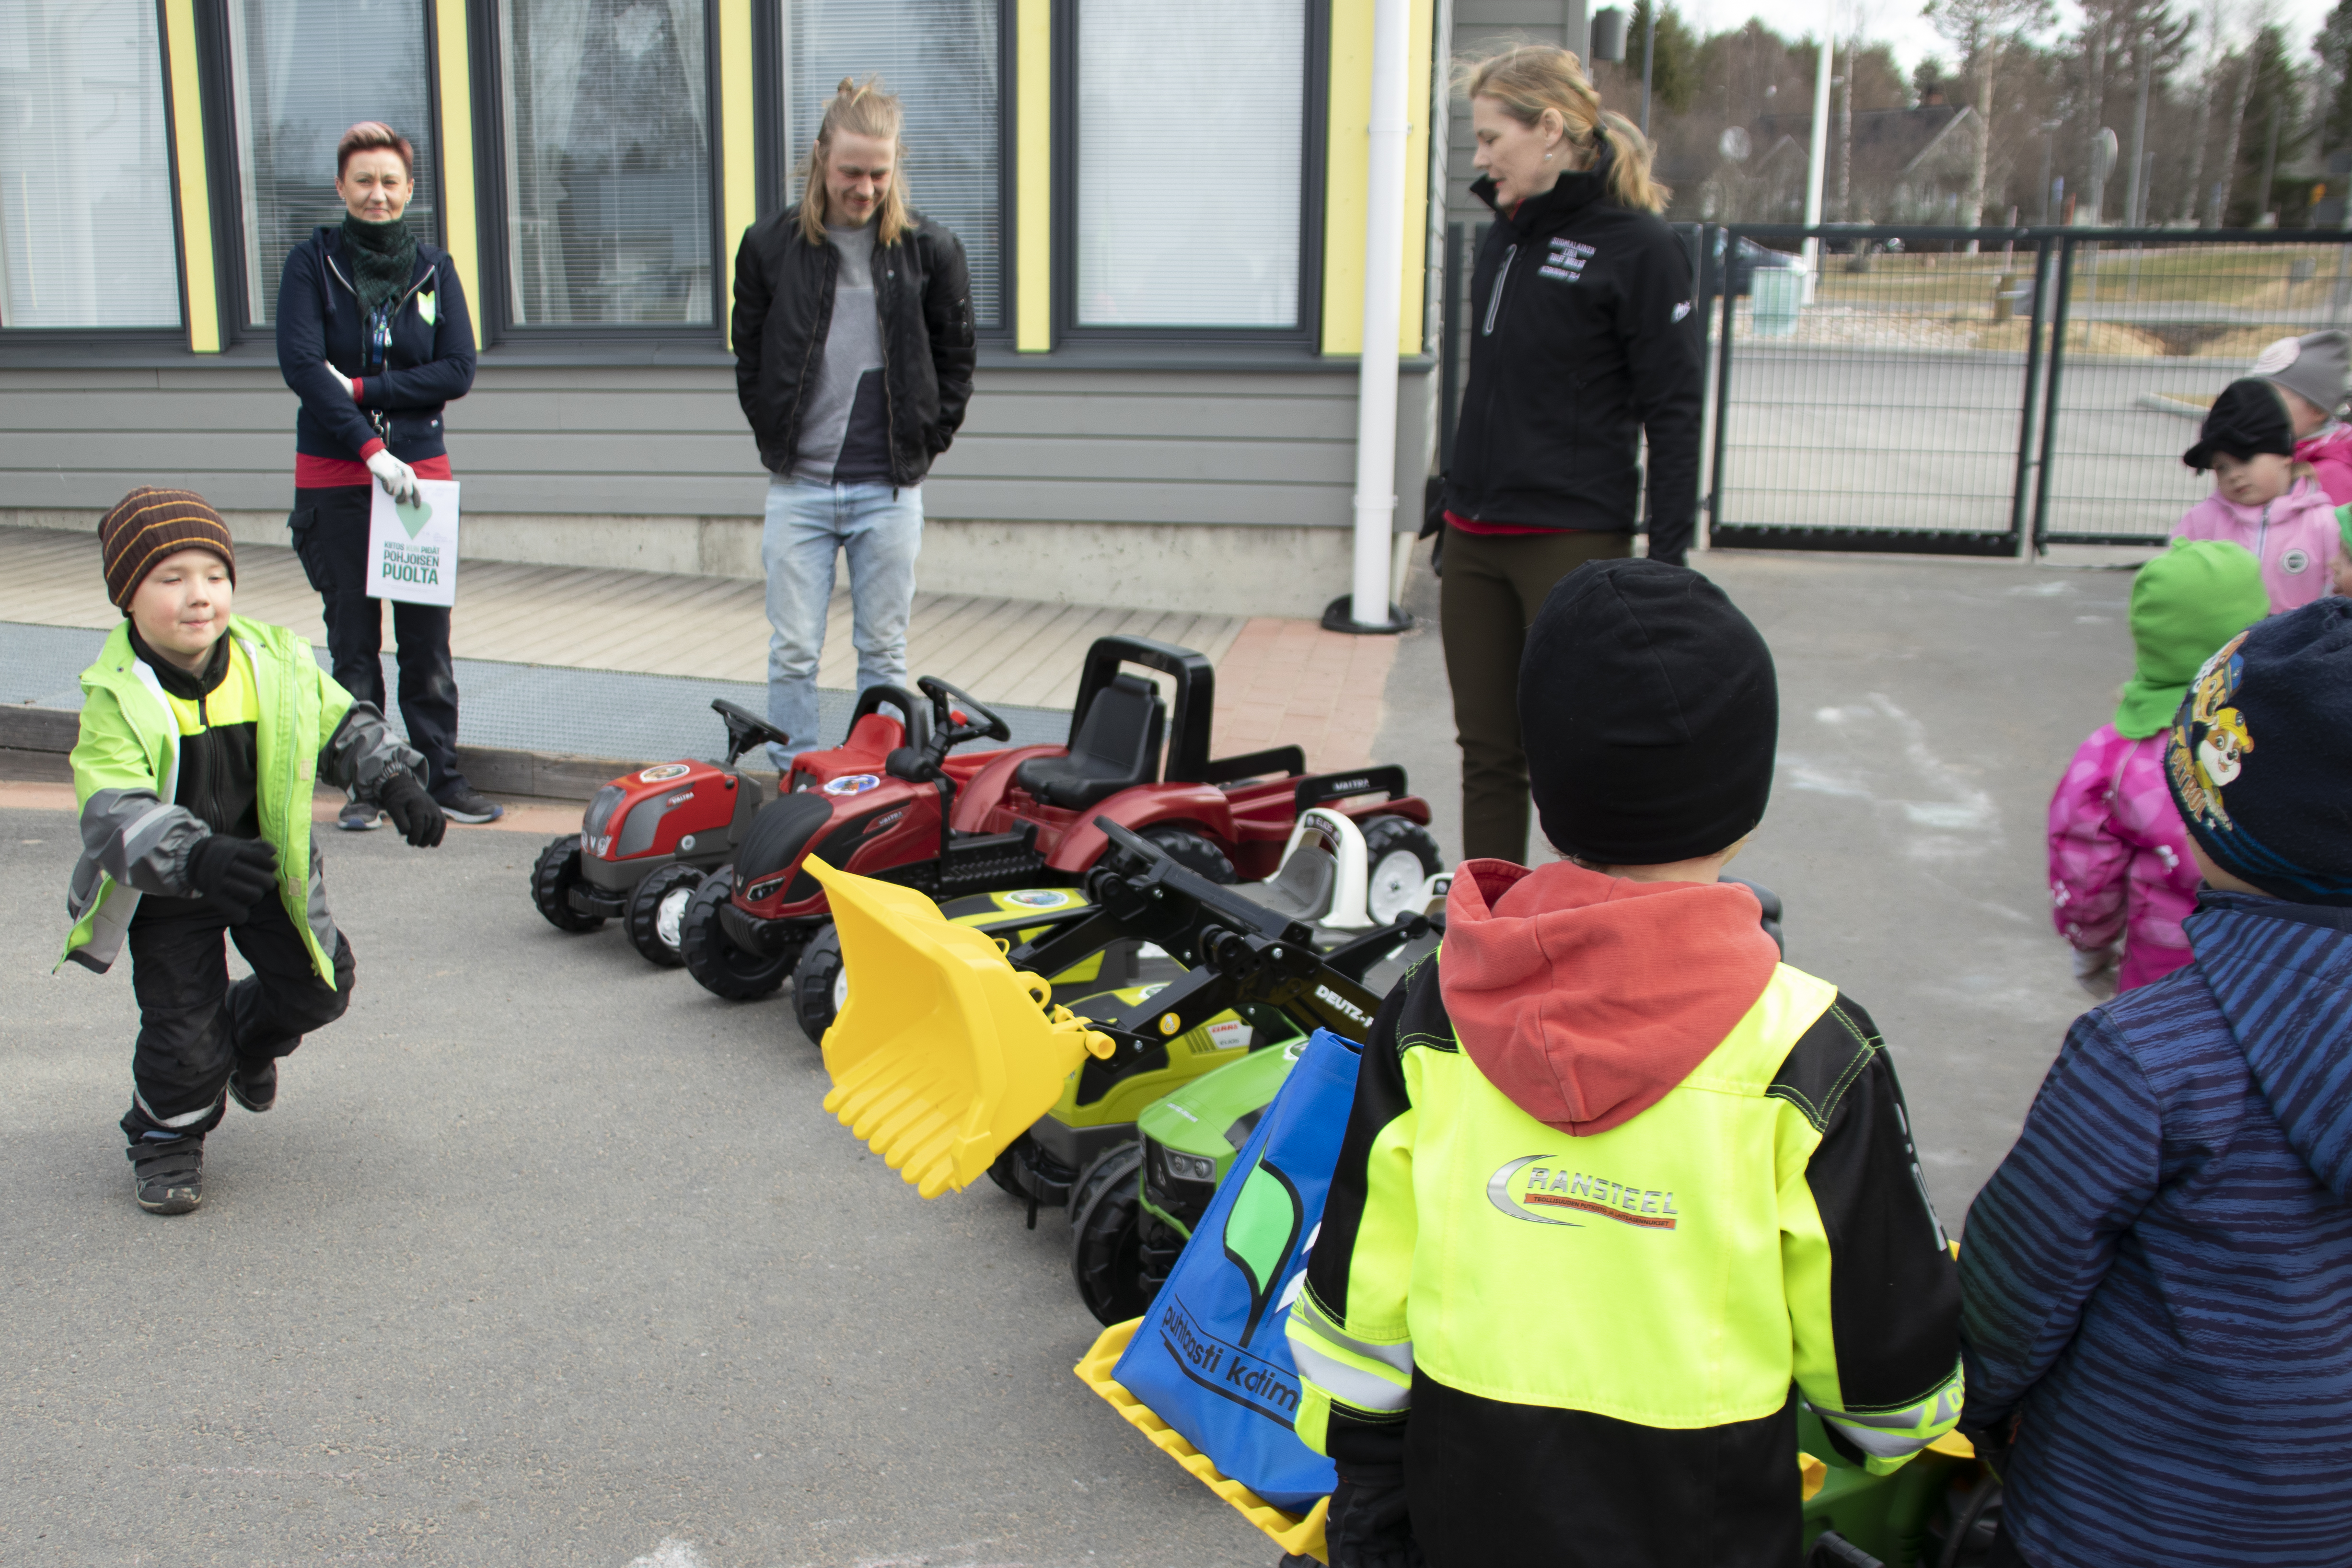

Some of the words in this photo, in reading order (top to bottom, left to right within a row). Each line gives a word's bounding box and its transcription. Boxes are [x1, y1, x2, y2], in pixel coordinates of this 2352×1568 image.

[1551, 237, 1597, 256] SUOMALAINEN
[1561, 248, 1578, 258] LIHA
[384, 540, 405, 550] KIITOS
[421, 546, 440, 554] PIDÄT
[383, 549, 440, 567] POHJOISEN
[382, 561, 439, 585] PUOLTA
[1334, 778, 1370, 791] VALTRA
[671, 791, 695, 804] VALTRA
[879, 811, 903, 826] VALTRA
[1315, 817, 1334, 833] ELIOS
[1527, 1167, 1679, 1214] RANSTEEL
[1534, 1196, 1579, 1207] TEOLLISUUDEN
[1615, 1212, 1669, 1227] LAITEASENNUKSET
[1161, 1305, 1224, 1373] puhtaasti
